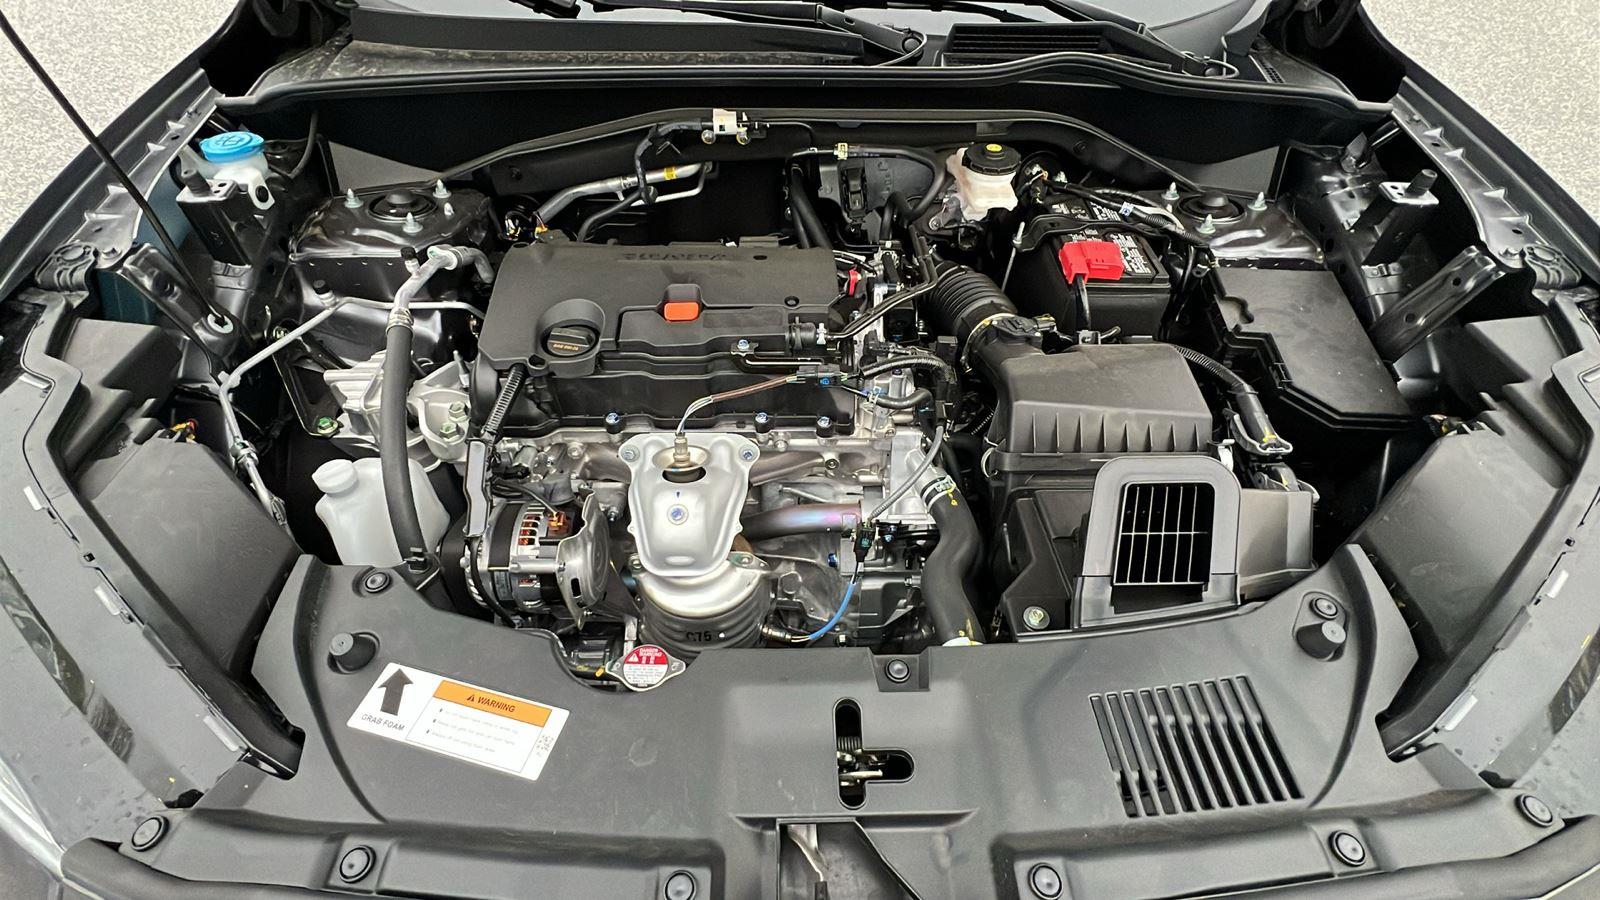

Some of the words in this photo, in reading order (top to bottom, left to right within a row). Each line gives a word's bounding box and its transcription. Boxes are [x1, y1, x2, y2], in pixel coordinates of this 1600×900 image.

[477, 696, 516, 713] WARNING
[361, 713, 383, 725] GRAB
[383, 719, 406, 731] FOAM
